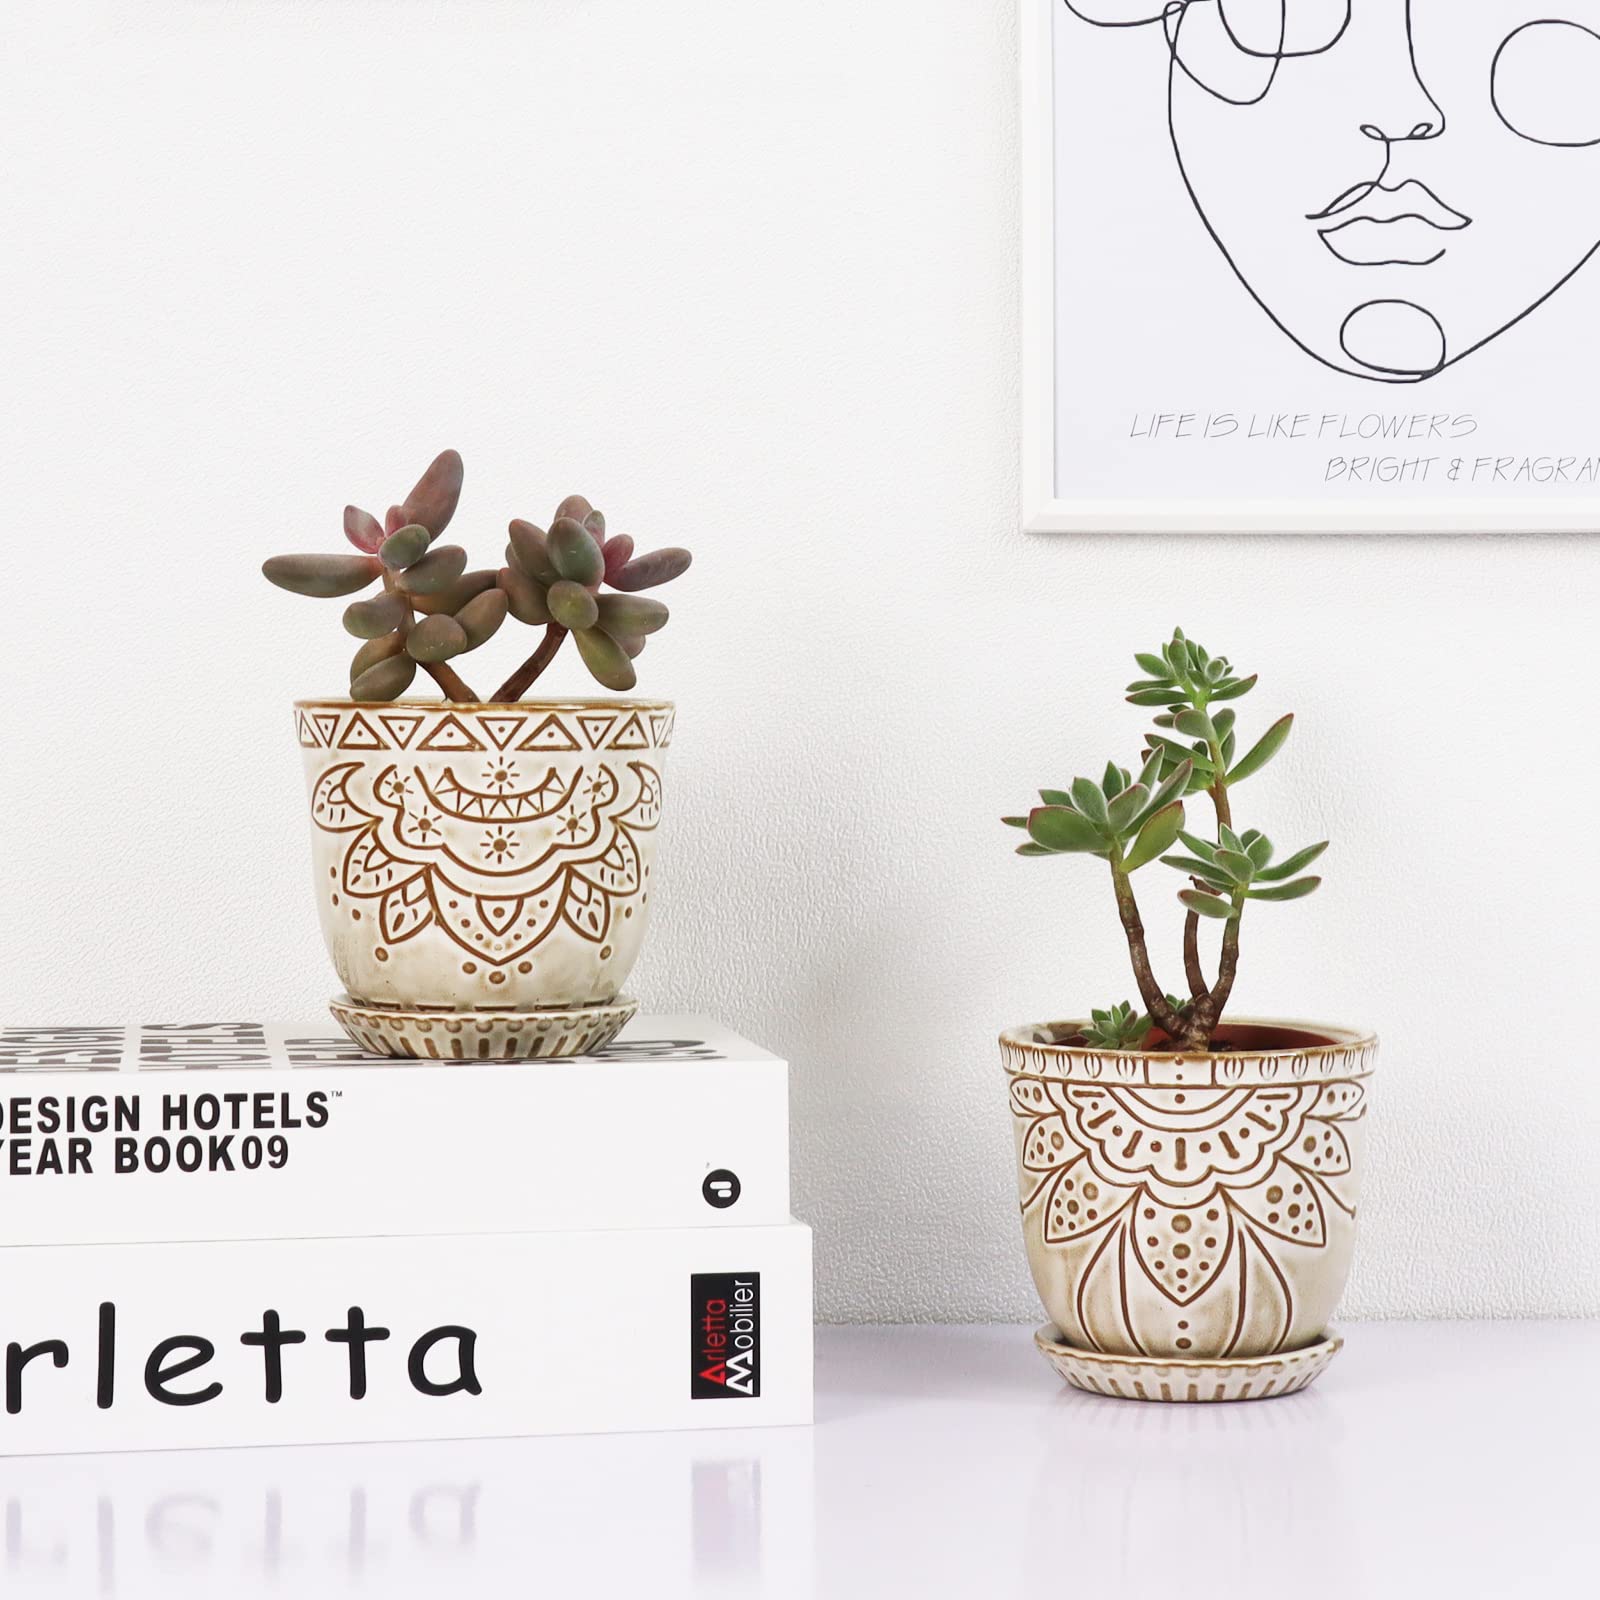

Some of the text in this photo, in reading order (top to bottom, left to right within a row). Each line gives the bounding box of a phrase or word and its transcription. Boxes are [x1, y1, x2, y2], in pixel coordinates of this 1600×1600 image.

[1129, 413, 1478, 439] LIFE IS LIKE FLOWERS
[1324, 456, 1440, 482] BRIGHT
[1446, 457, 1465, 482] &
[0, 1095, 140, 1134] ESIGN
[0, 1138, 94, 1176] EAR
[699, 1299, 727, 1385] Arletta
[725, 1279, 754, 1395] Mobilier
[5, 1301, 483, 1414] rletta
